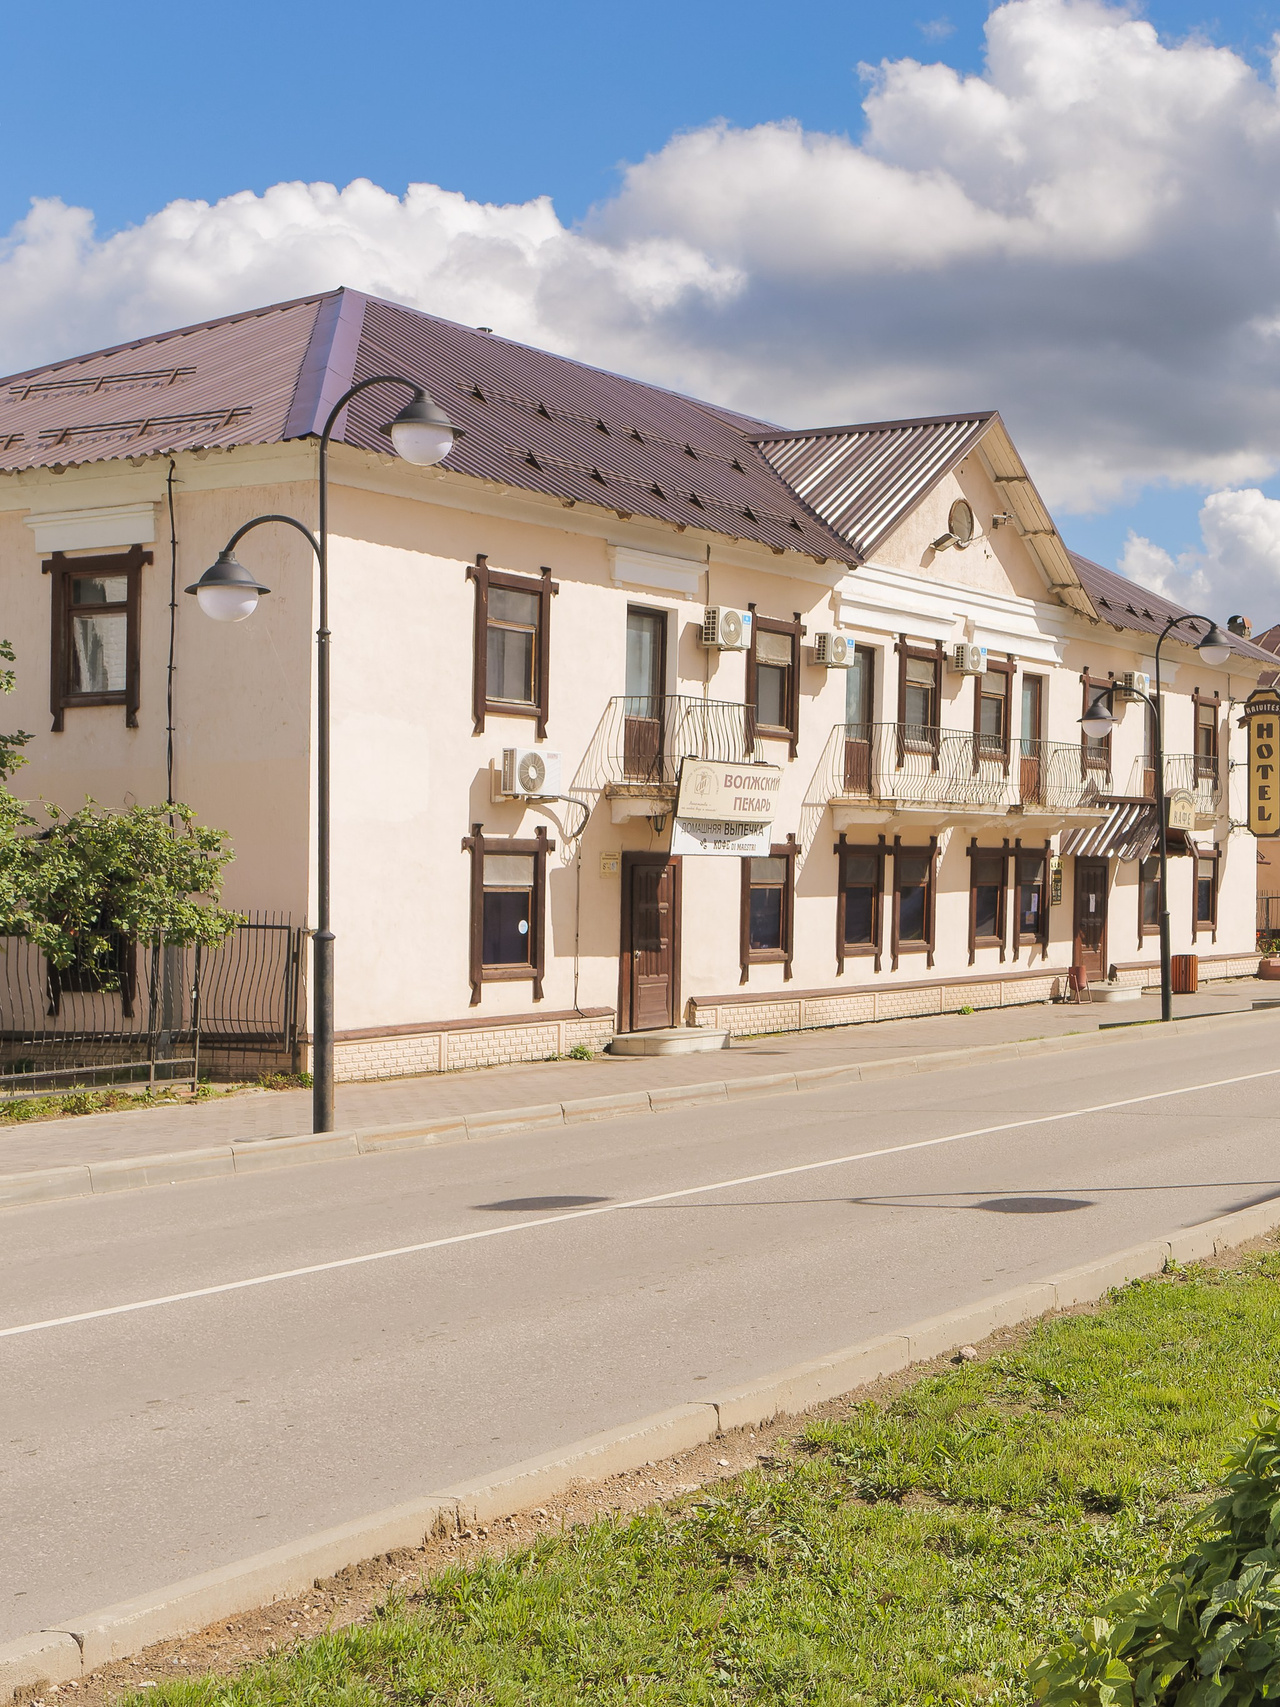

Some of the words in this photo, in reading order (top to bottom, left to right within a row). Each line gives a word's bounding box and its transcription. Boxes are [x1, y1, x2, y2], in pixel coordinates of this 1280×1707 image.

[1256, 723, 1274, 821] HOTEL
[723, 774, 781, 791] ВОЛЖСКИЙ
[733, 797, 771, 812] ПЕКАРЬ
[1173, 810, 1191, 825] КАФЕ
[681, 822, 722, 835] ДОМАШНЯЯ
[724, 822, 764, 837] ВЫПЕЧКА
[713, 839, 731, 850] КОФЕ
